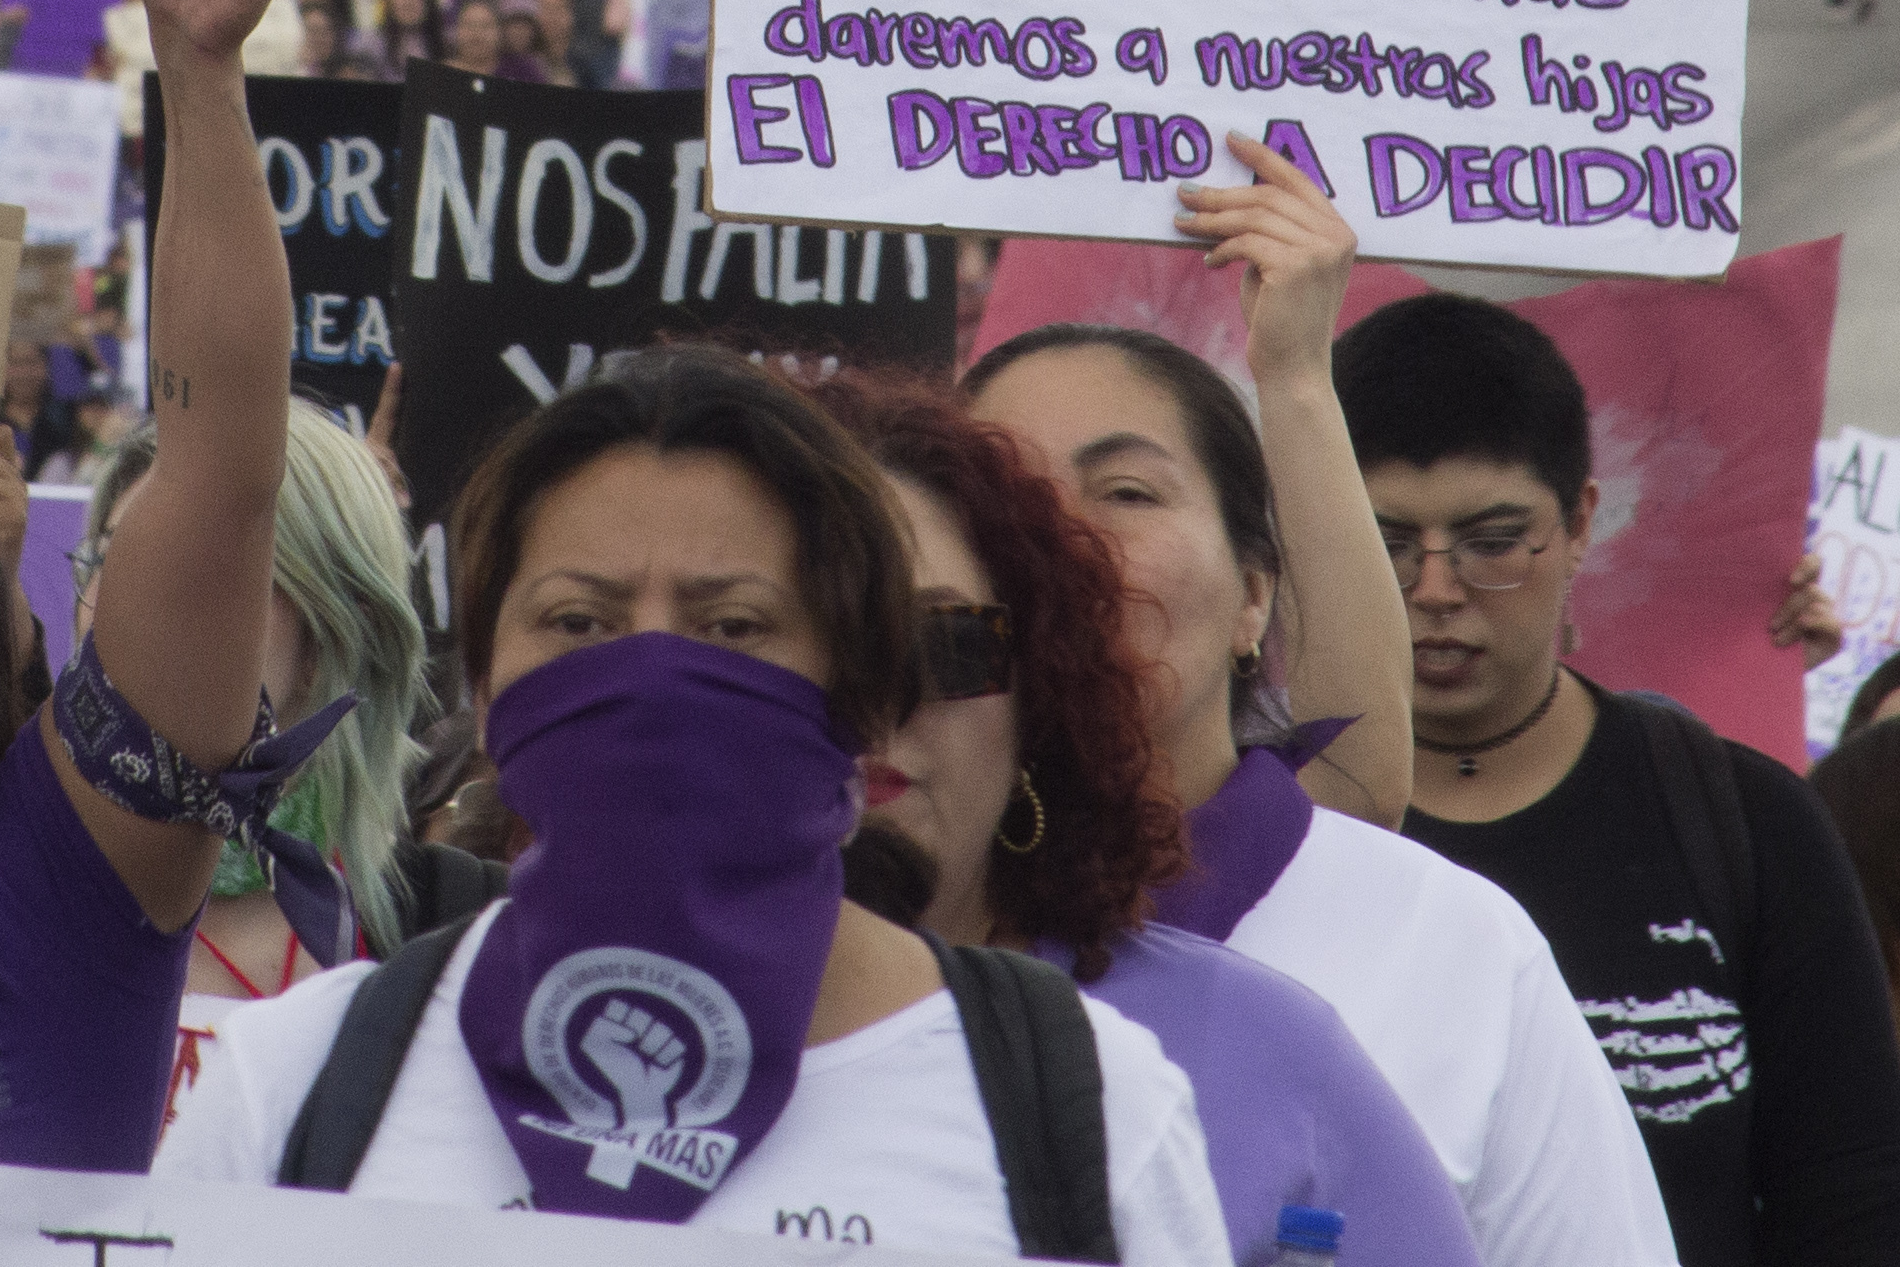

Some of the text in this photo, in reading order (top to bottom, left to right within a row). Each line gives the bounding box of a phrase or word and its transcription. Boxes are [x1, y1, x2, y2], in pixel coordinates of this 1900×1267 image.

[1116, 27, 1167, 85] a
[1196, 31, 1495, 110] nuestras
[1521, 33, 1713, 132] hijas
[411, 113, 647, 290] NOS
[888, 89, 1212, 181] DERECHO
[1252, 119, 1336, 202] A
[1363, 132, 1739, 232] DECIDIR
[291, 291, 396, 368] EA
[1823, 440, 1900, 535] AL
